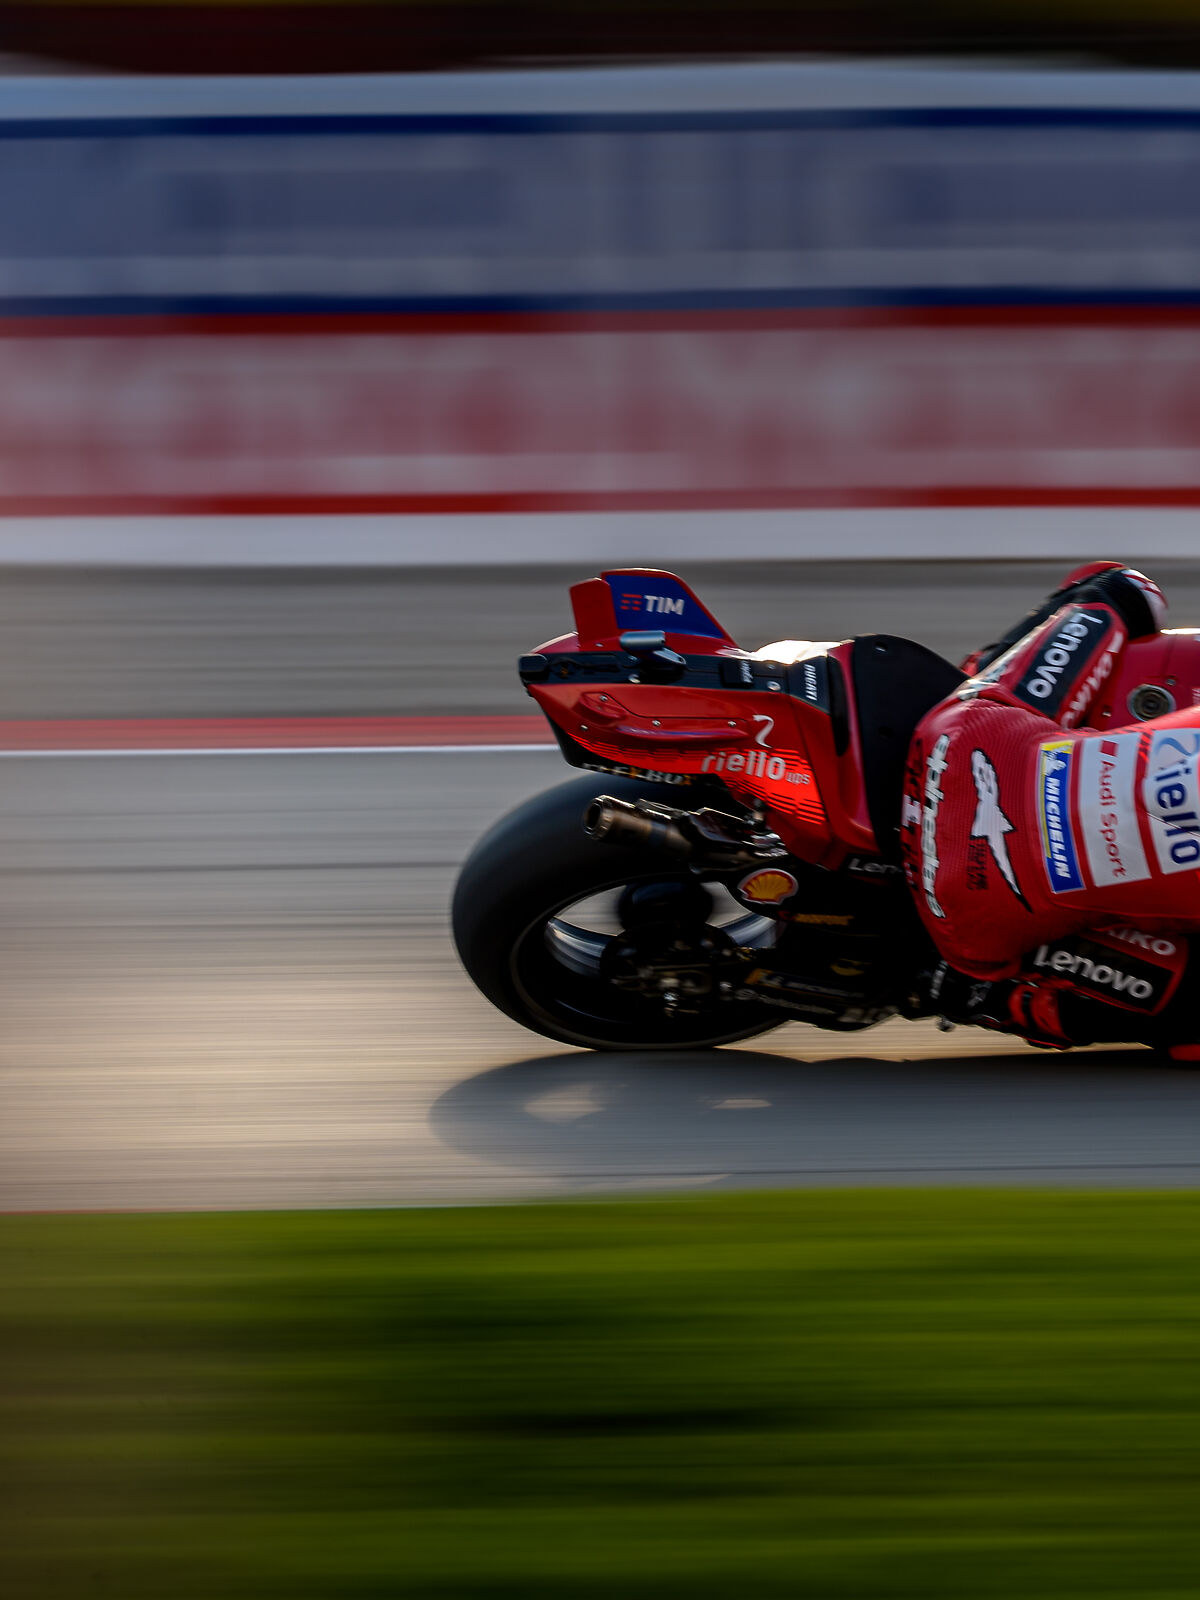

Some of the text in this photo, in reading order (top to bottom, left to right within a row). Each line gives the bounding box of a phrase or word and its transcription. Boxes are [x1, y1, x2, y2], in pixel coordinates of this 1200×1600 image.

[645, 594, 684, 616] TIM
[804, 663, 818, 701] DUCATI
[1026, 611, 1104, 699] Lenovo
[701, 751, 786, 781] riello
[1045, 777, 1072, 879] MICHELIN
[1098, 760, 1128, 878] Audi Sport
[1034, 944, 1153, 999] Lenovo
